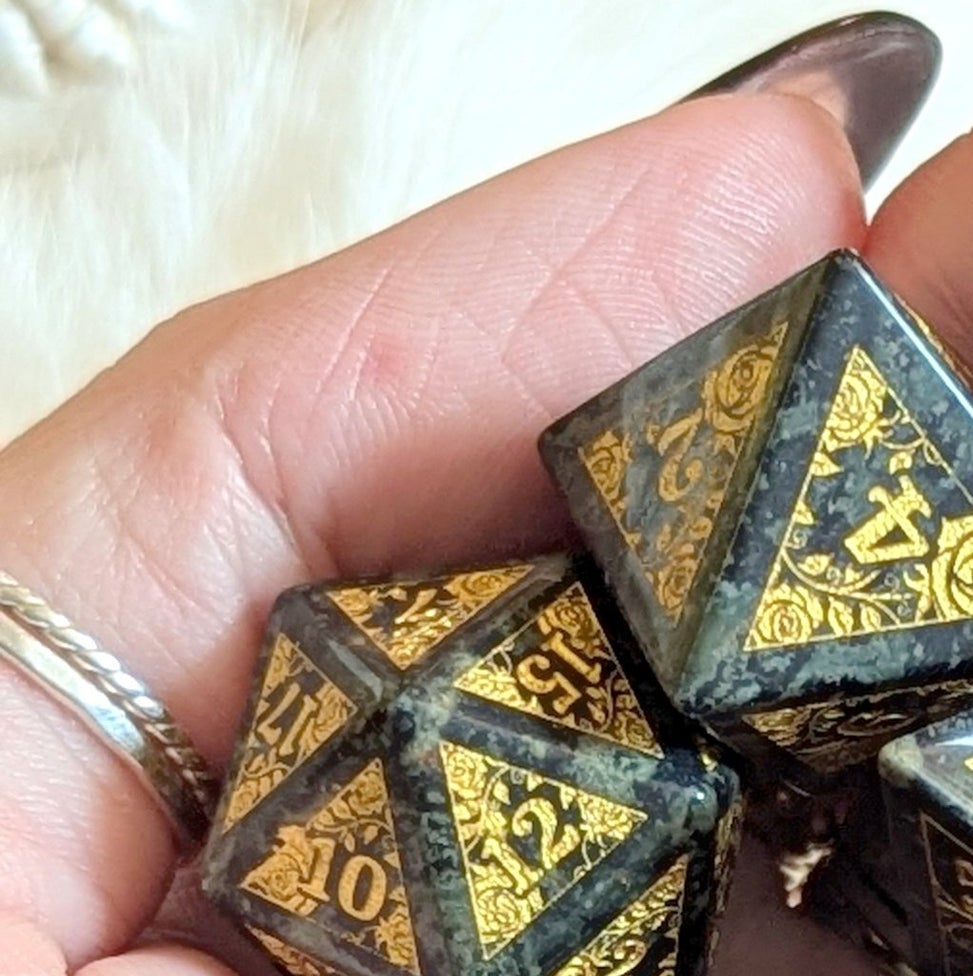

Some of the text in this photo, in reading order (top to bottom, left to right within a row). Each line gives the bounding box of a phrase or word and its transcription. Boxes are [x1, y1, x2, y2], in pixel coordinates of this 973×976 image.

[844, 475, 932, 566] 4
[517, 631, 602, 716] 15
[256, 682, 318, 756] 17
[296, 837, 387, 922] 10
[475, 797, 581, 895] 12
